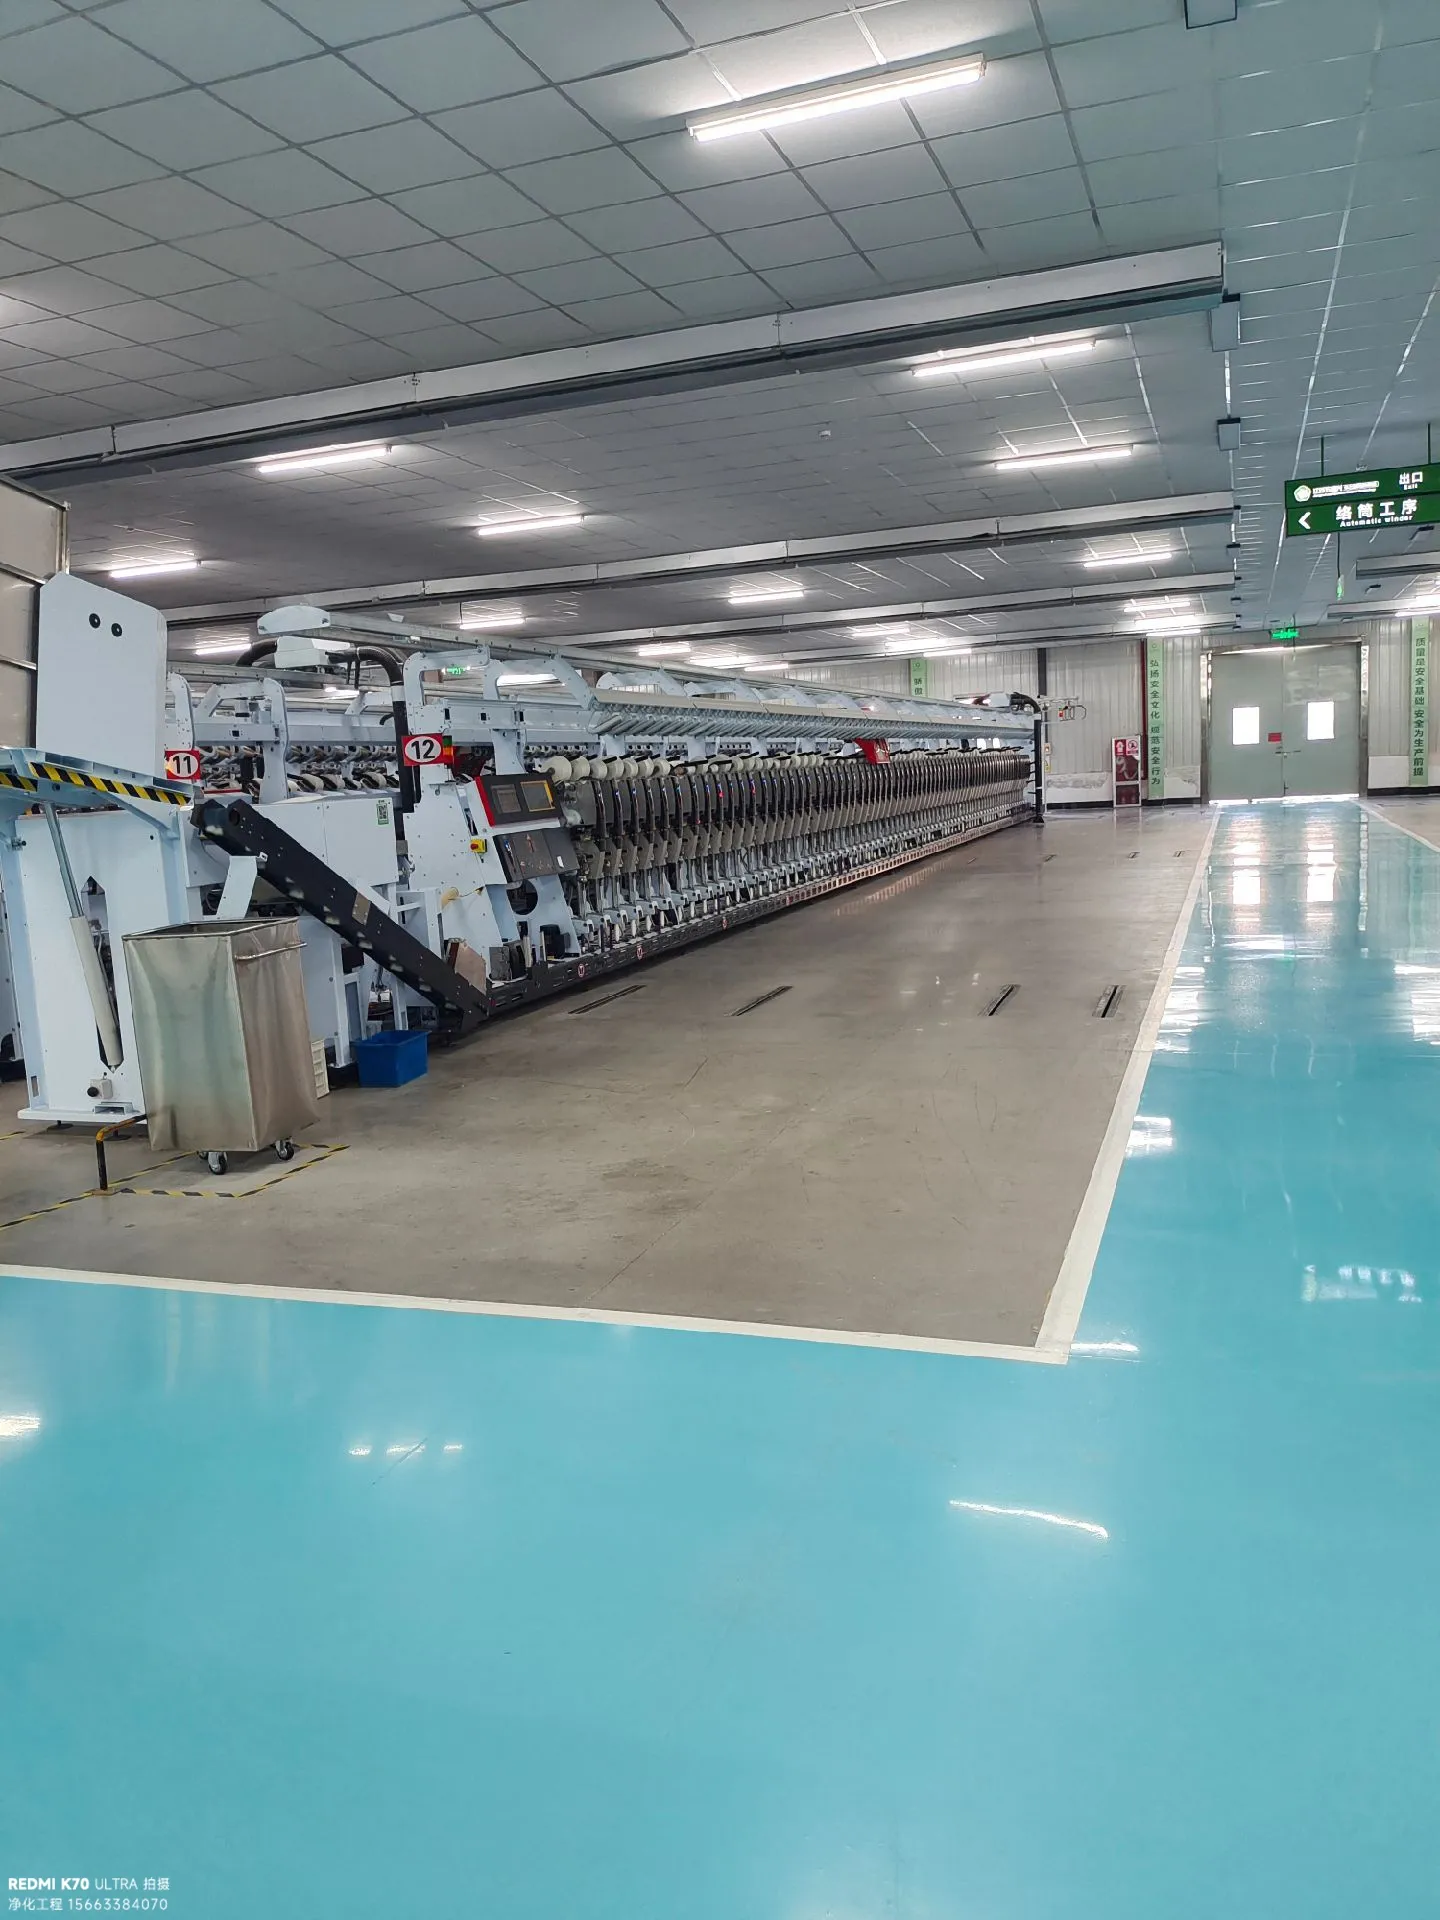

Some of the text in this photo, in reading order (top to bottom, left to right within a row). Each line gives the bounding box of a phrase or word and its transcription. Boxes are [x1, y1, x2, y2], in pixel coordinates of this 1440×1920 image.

[1399, 471, 1424, 485] 出口
[1335, 498, 1418, 521] 络筒工序
[1339, 514, 1413, 528] Automatic winder
[1413, 637, 1426, 776] 质量是安全基础 安全为生产前提
[1150, 659, 1160, 785] 弘扬安全文化 规范安全行为
[410, 738, 436, 760] 12
[172, 755, 192, 775] 11
